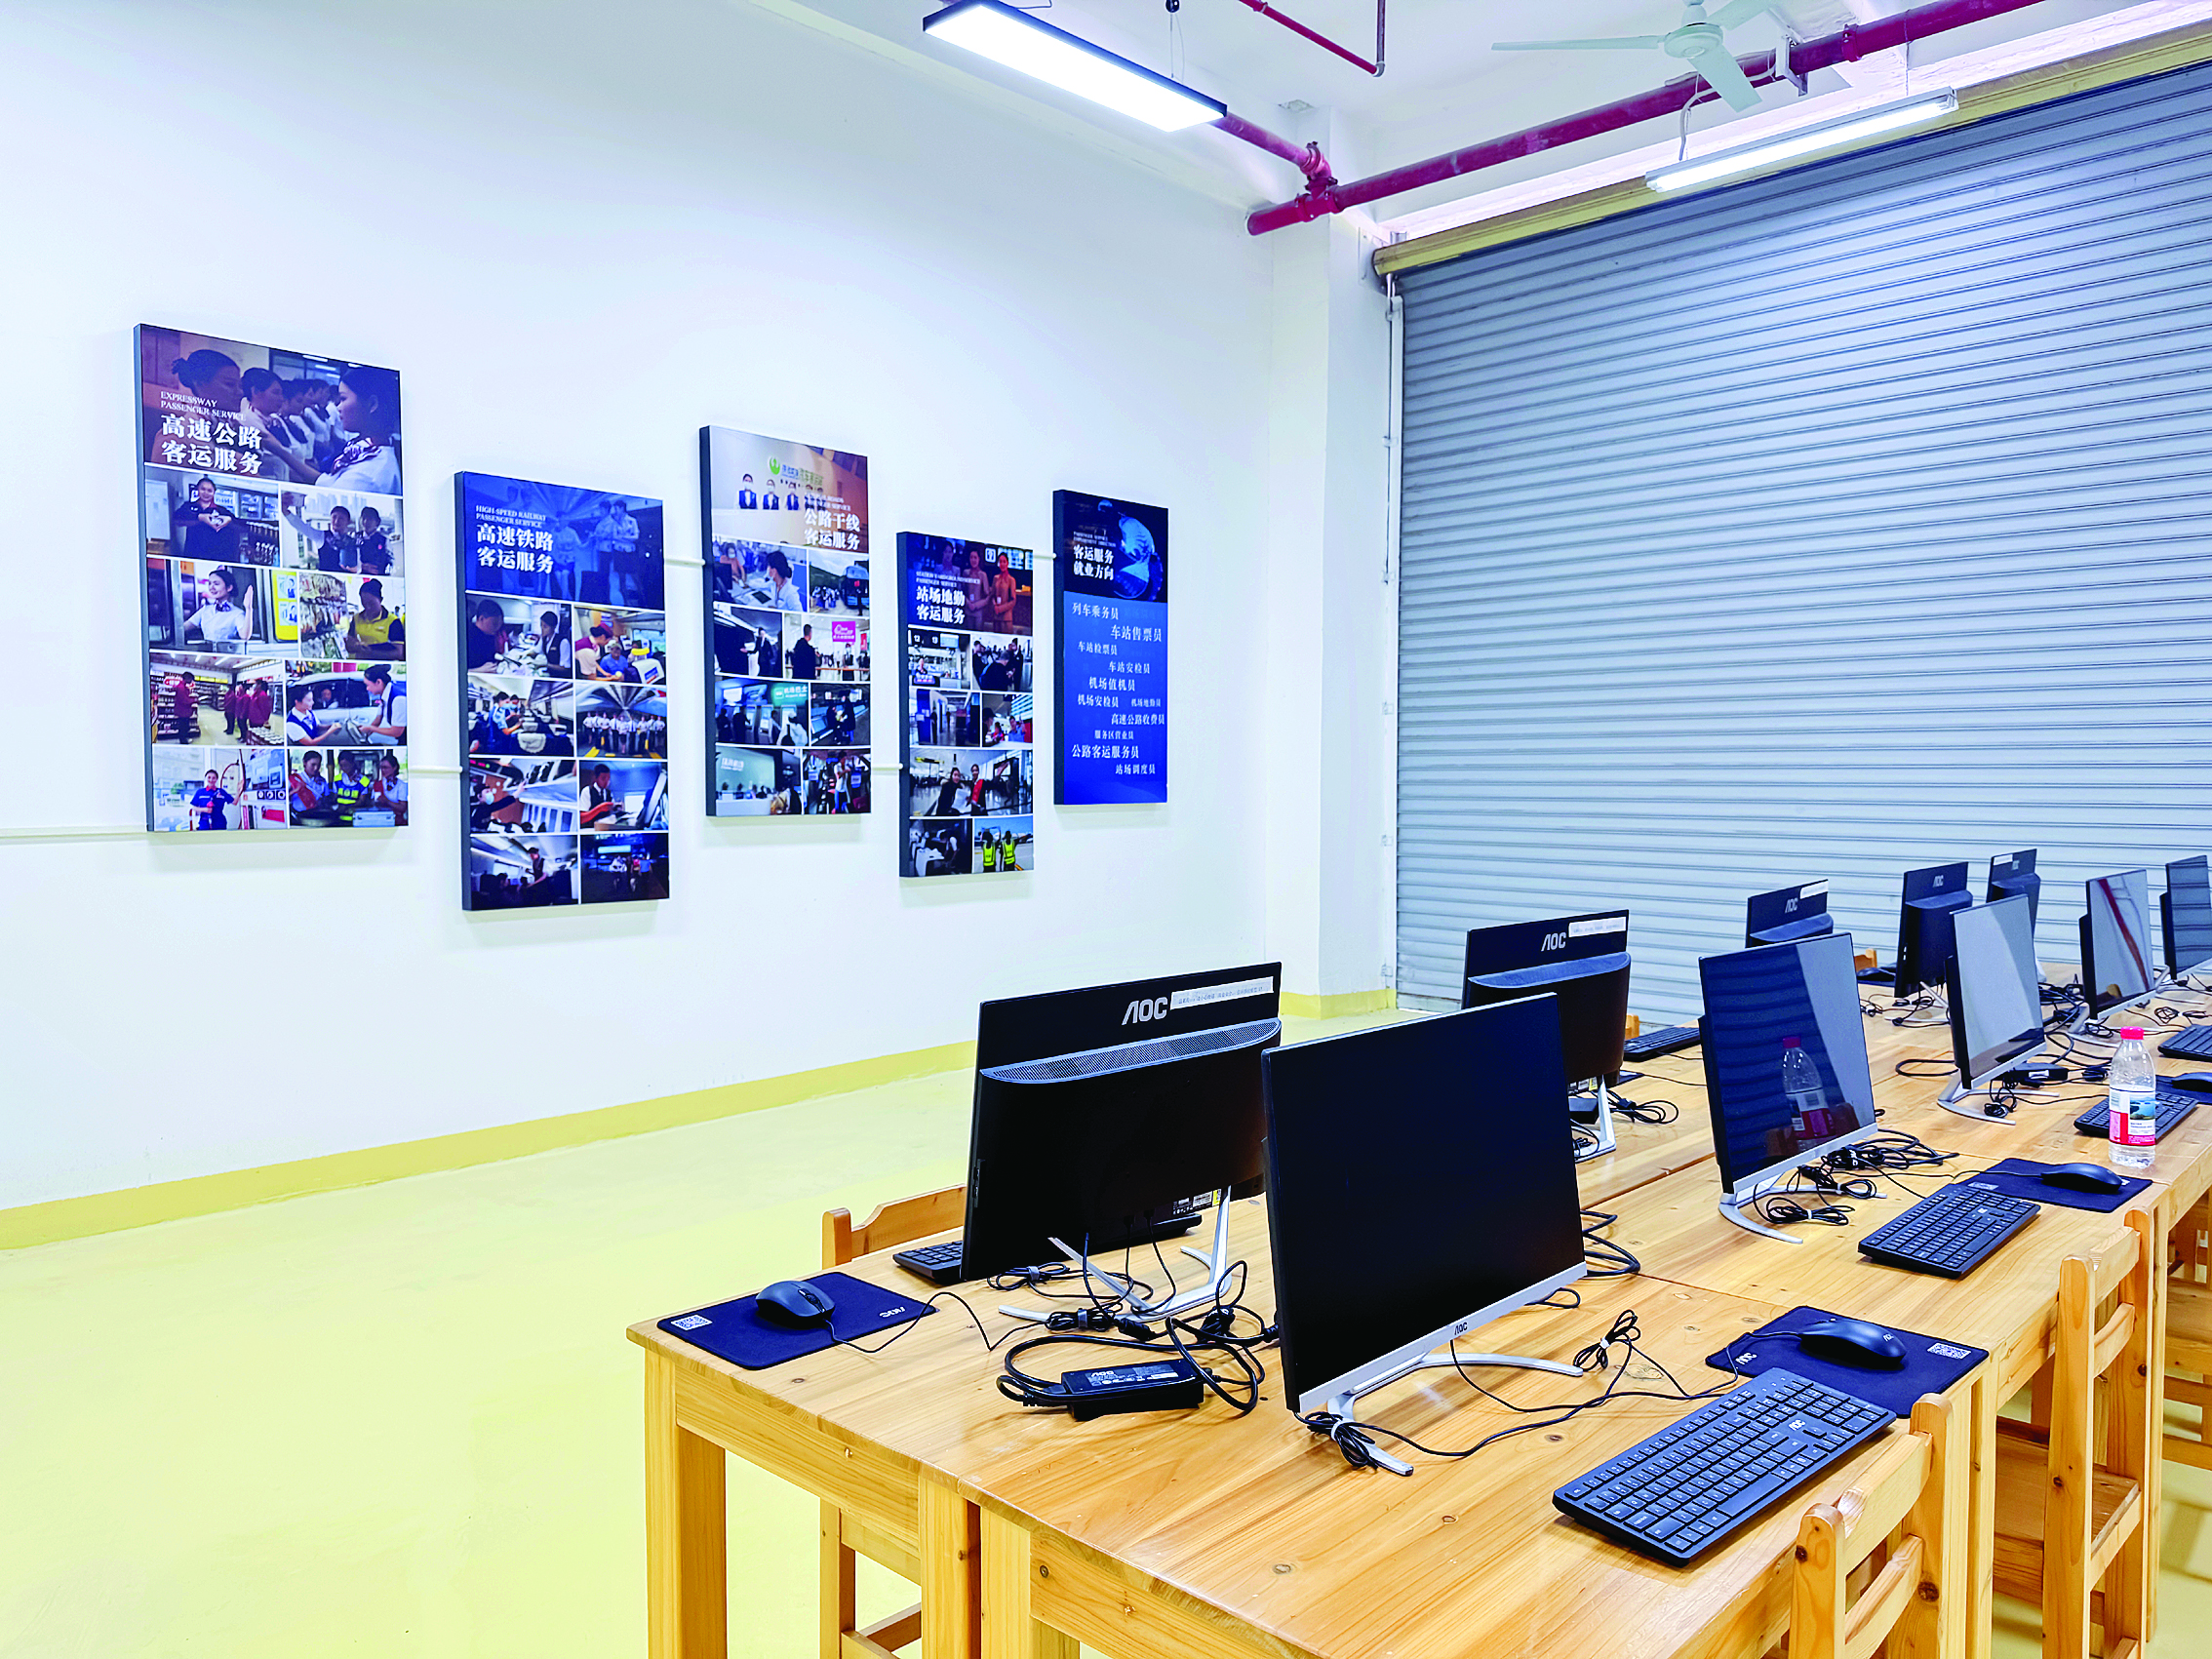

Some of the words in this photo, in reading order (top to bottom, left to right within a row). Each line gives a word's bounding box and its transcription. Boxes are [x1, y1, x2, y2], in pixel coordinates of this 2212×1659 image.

[160, 391, 217, 408] EXPRESSWAY
[160, 400, 210, 415] PASSENGER
[212, 409, 246, 421] SERVICE
[161, 414, 262, 450] 高速公路
[161, 440, 262, 475] 客运服务
[804, 507, 860, 532] 公路干线
[476, 523, 554, 552] 高速铁路
[804, 527, 860, 550] 客运服务
[477, 546, 554, 573] 客运服务
[1073, 544, 1114, 565] 客运服务
[1073, 560, 1114, 580] 就业方向
[916, 603, 966, 624] 客运服务
[1072, 602, 1119, 620] 列车乘务员
[1110, 624, 1162, 643] 车站售票员
[1077, 641, 1118, 655] 车站检票员
[1108, 660, 1150, 674] 车站安检员
[1088, 676, 1135, 691] 机场值机员
[1078, 693, 1119, 708] 机场安检员
[1071, 743, 1139, 759] 公路客运服务员
[1785, 897, 1798, 914] AOC
[1541, 931, 1566, 952] AOC
[1122, 996, 1168, 1026] AOC
[1454, 1322, 1468, 1335] AOC
[1882, 1333, 1895, 1342] AOC
[1735, 1352, 1758, 1365] AOC
[1788, 1419, 1806, 1431] AOC
